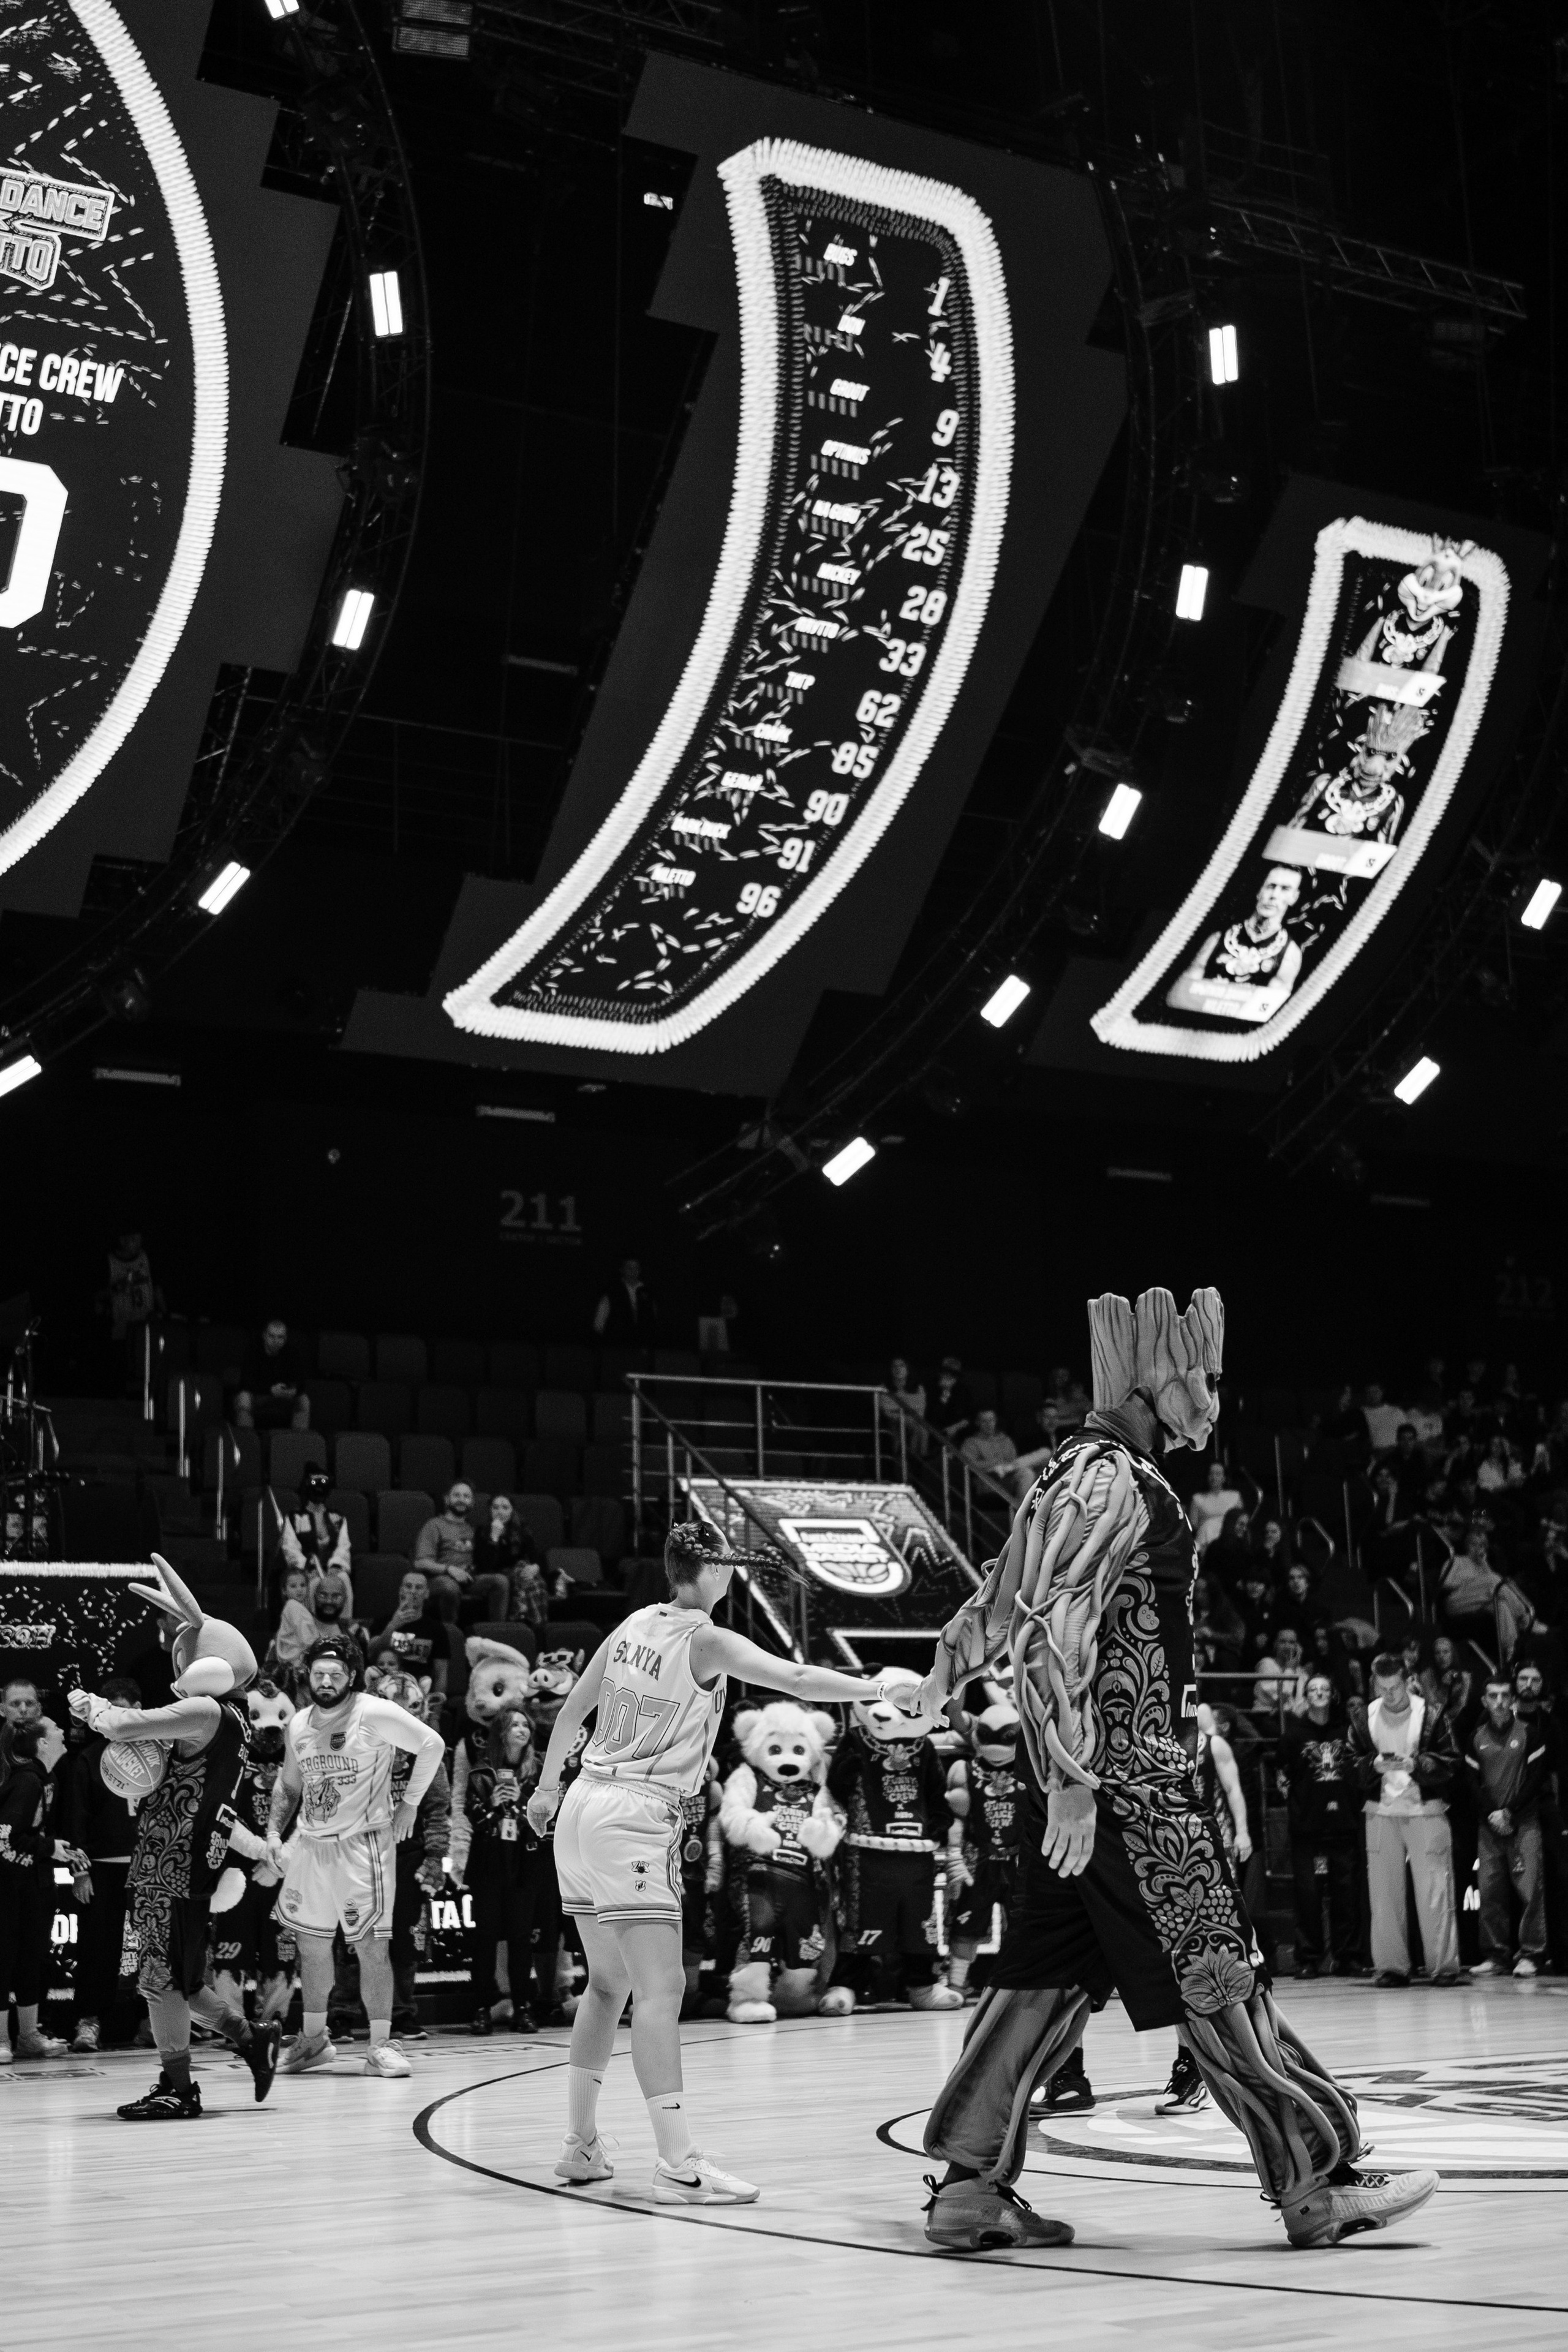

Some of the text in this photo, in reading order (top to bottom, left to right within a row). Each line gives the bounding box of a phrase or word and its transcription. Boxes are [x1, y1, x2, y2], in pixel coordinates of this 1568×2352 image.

[0, 178, 107, 231] DANCE
[927, 276, 951, 316] 1
[39, 353, 124, 403] CREW
[932, 409, 960, 447] 9
[917, 464, 960, 508] 13
[902, 524, 951, 566] 25
[899, 585, 948, 625] 28
[878, 638, 927, 677] 33
[856, 689, 902, 728] 62
[831, 741, 880, 778] 85
[803, 789, 850, 826] 90
[777, 837, 816, 873] 91
[736, 882, 782, 918] 96
[499, 1189, 582, 1232] 211
[592, 1676, 680, 1760] 007
[337, 1774, 356, 1785] 333
[215, 1942, 242, 1959] 29
[750, 1936, 775, 1953] 90
[858, 1930, 883, 1945] 17
